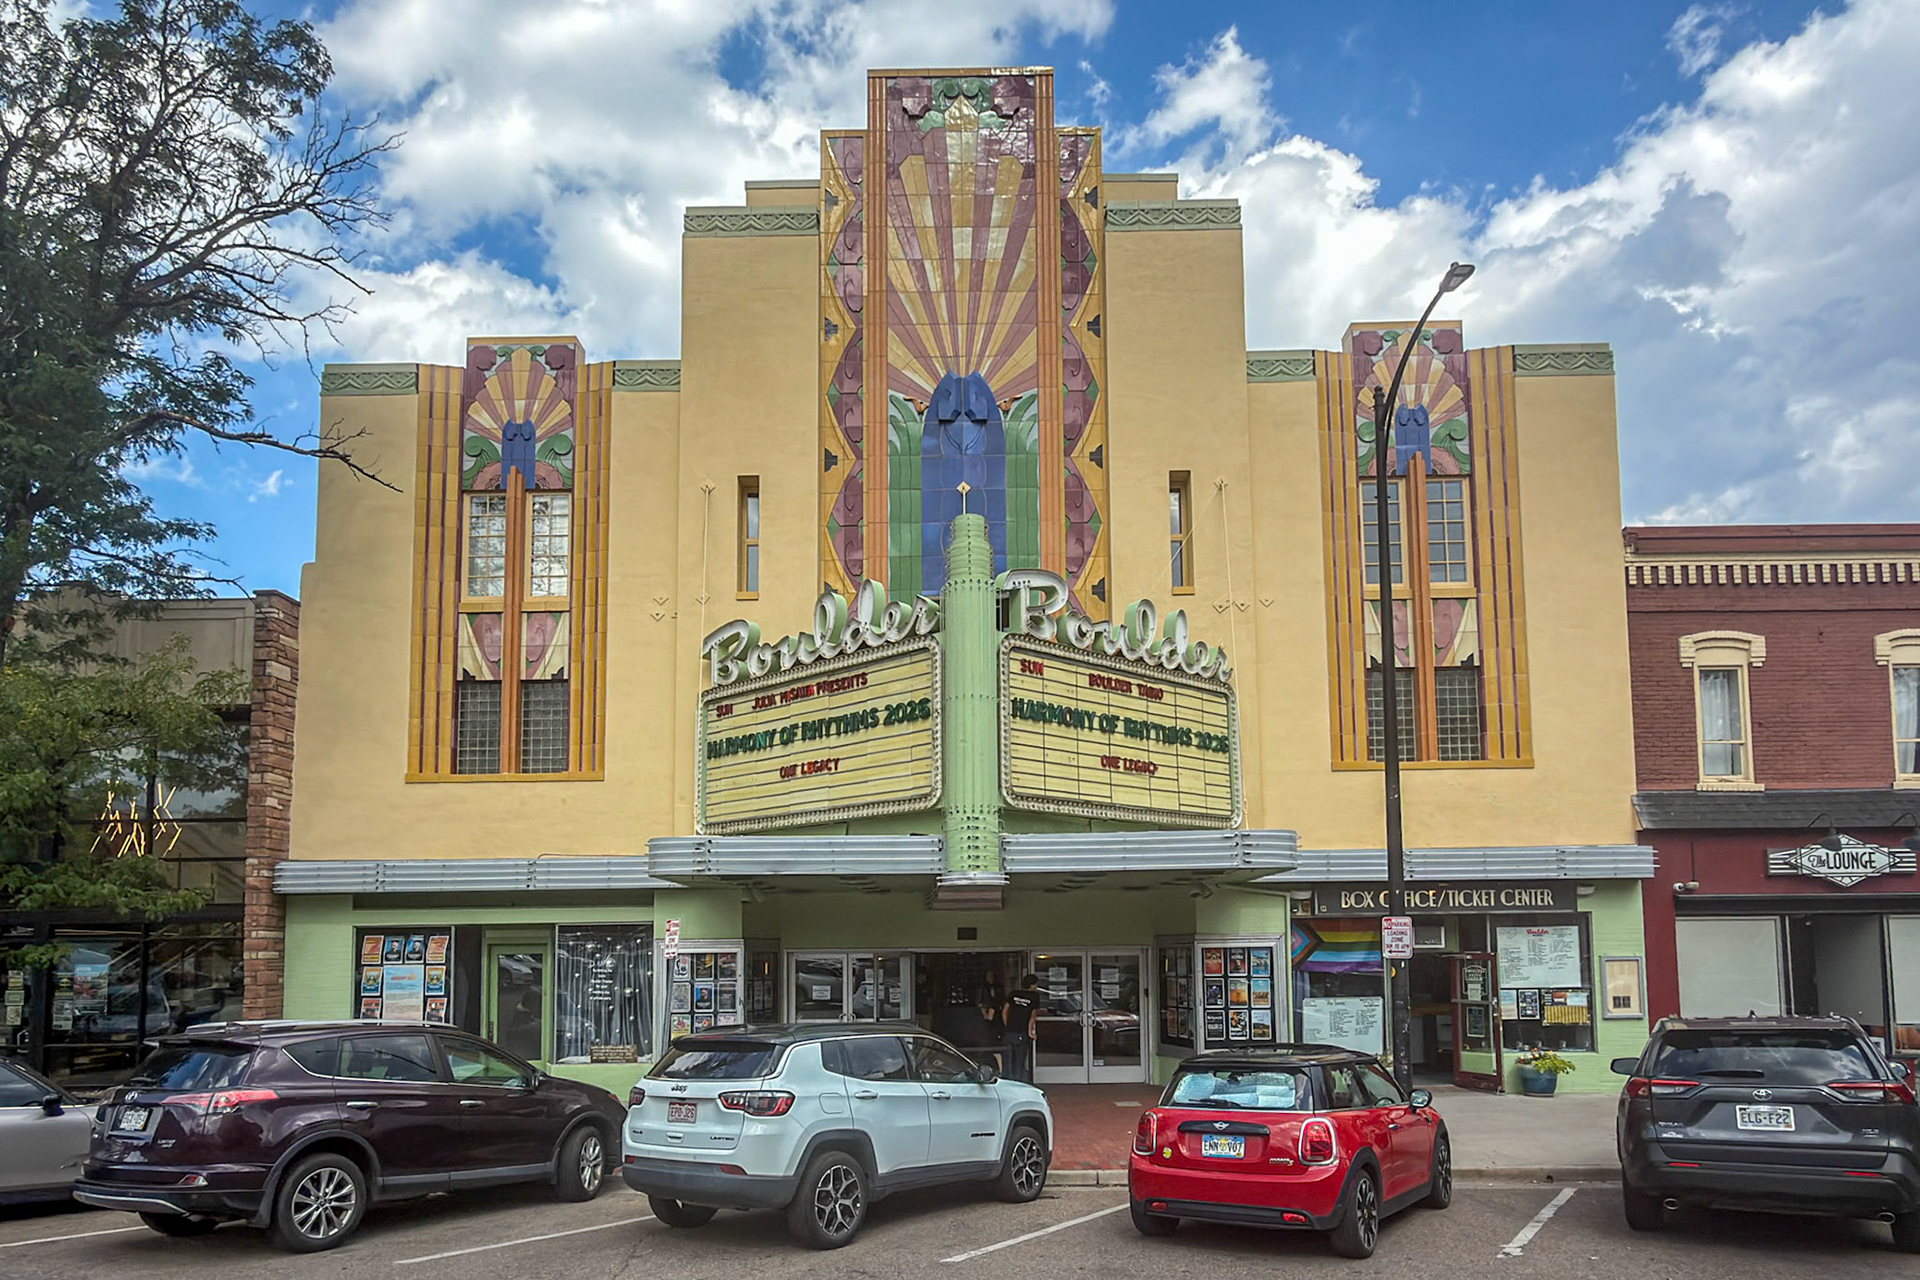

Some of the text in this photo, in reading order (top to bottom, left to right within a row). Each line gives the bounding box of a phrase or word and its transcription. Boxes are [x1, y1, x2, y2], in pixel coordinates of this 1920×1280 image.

[702, 579, 939, 687] Boulder
[996, 569, 1233, 682] Boulder
[1020, 658, 1043, 675] SUN
[816, 672, 869, 695] PRESENTS
[1088, 673, 1132, 694] BOULDER
[716, 703, 733, 718] SUN
[1010, 697, 1096, 732] HARMONY
[1099, 713, 1120, 735] OF
[1124, 716, 1192, 747] RHYTHMS
[707, 728, 776, 760] HARMONY
[780, 723, 800, 746] OF
[801, 707, 880, 742] RHYTHMS
[780, 758, 840, 779] ONE LEGACY
[1100, 755, 1158, 776] ONE LEGACY
[1808, 851, 1878, 870] The LOUNGE
[1341, 890, 1375, 908] BOX
[1500, 888, 1554, 907] CENTER
